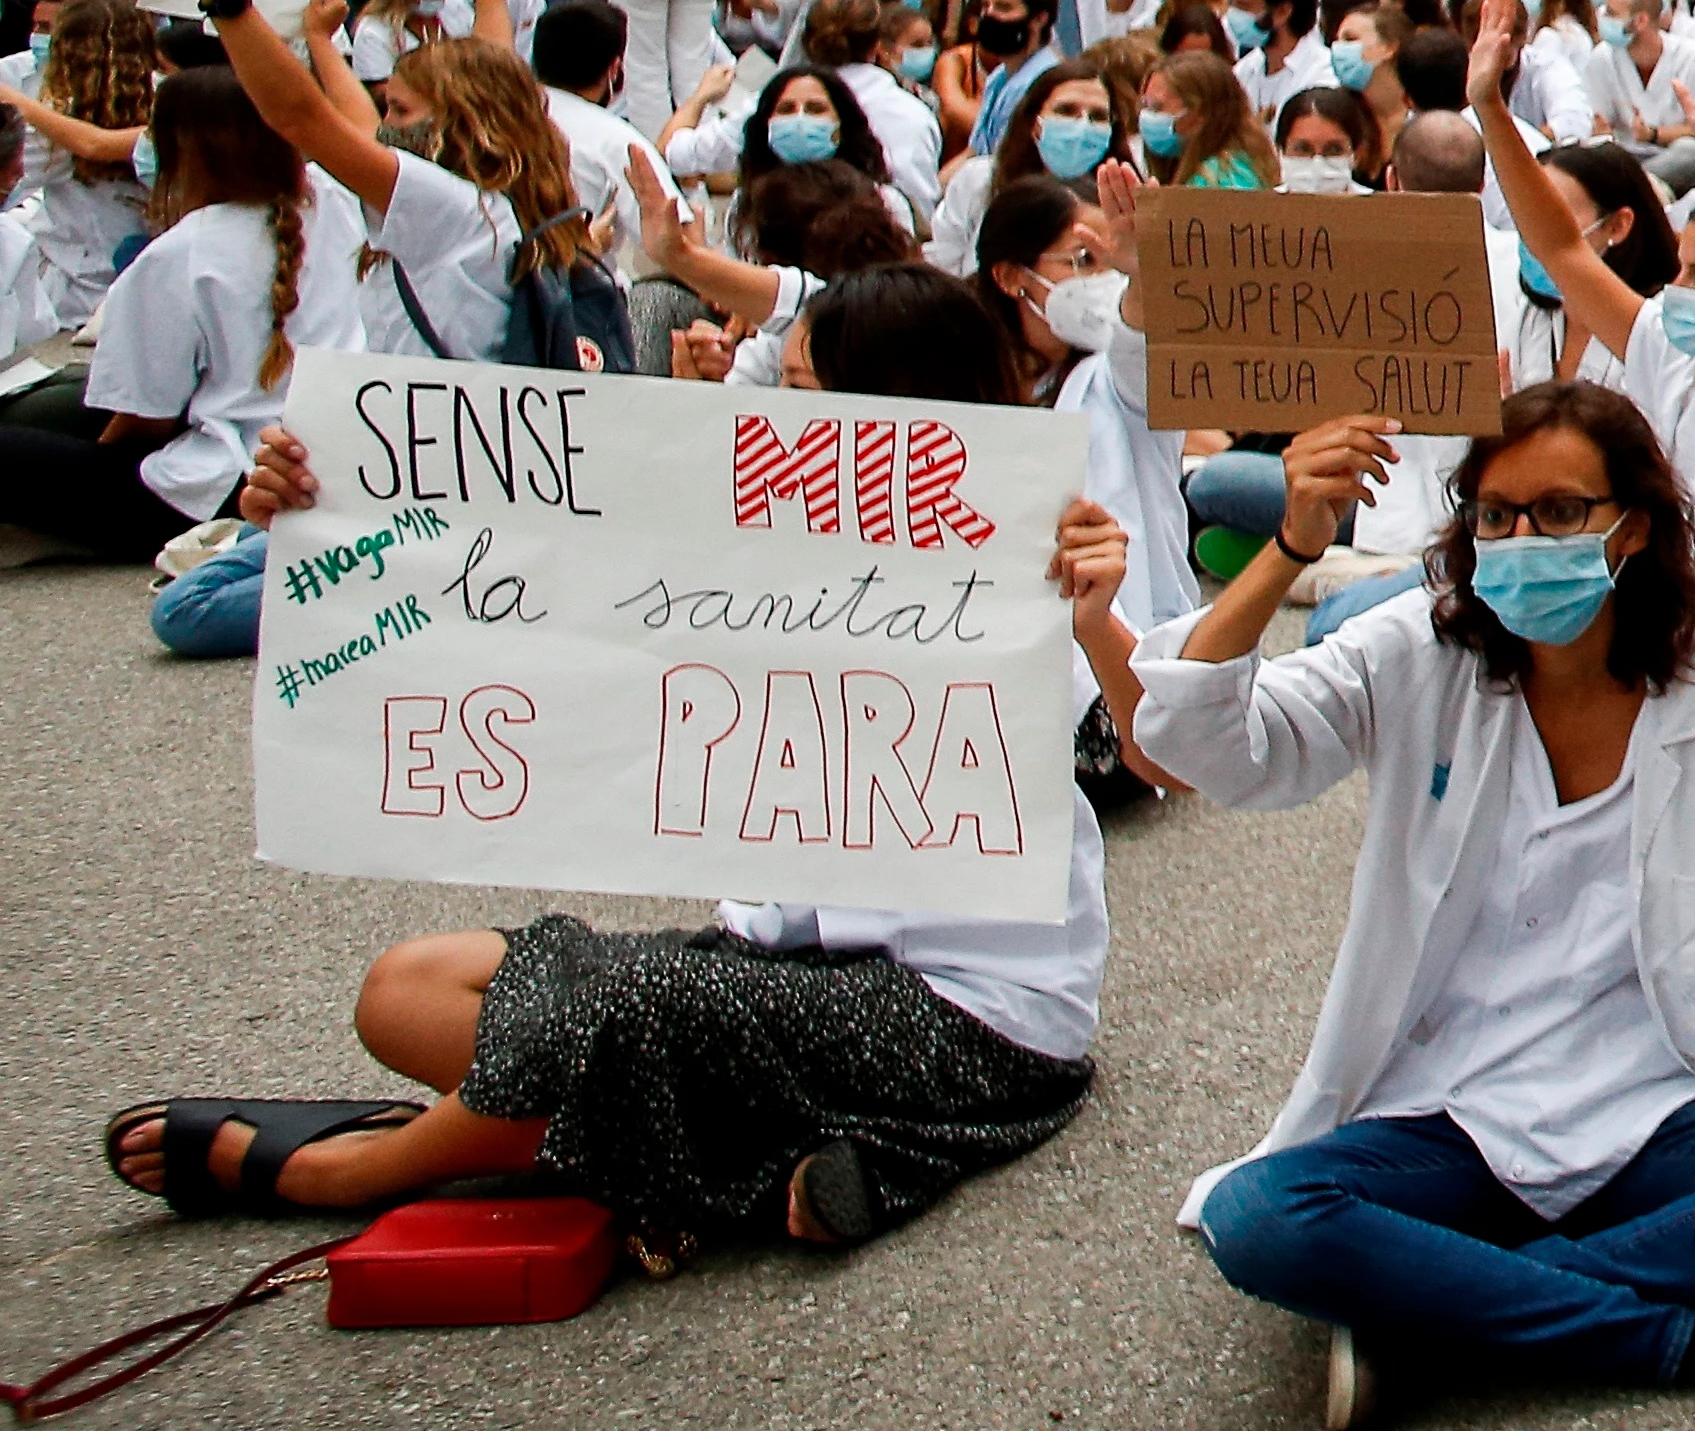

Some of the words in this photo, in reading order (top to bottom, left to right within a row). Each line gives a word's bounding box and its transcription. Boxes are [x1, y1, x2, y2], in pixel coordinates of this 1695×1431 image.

[1169, 218, 1209, 267] LA
[1230, 221, 1333, 270] MEUA
[1174, 267, 1462, 344] SUPERVISIÓ
[1170, 359, 1214, 399] LA
[1232, 360, 1317, 404] TEUA
[1354, 354, 1473, 416] SALUT
[356, 381, 602, 516] SENSE
[734, 414, 996, 549] MIR
[284, 506, 450, 604] #vagaMIR
[442, 527, 548, 623] la
[615, 566, 994, 644] sanitat
[274, 594, 432, 708] #mareaMIR
[381, 684, 536, 821] ES
[655, 663, 1022, 855] PARA
